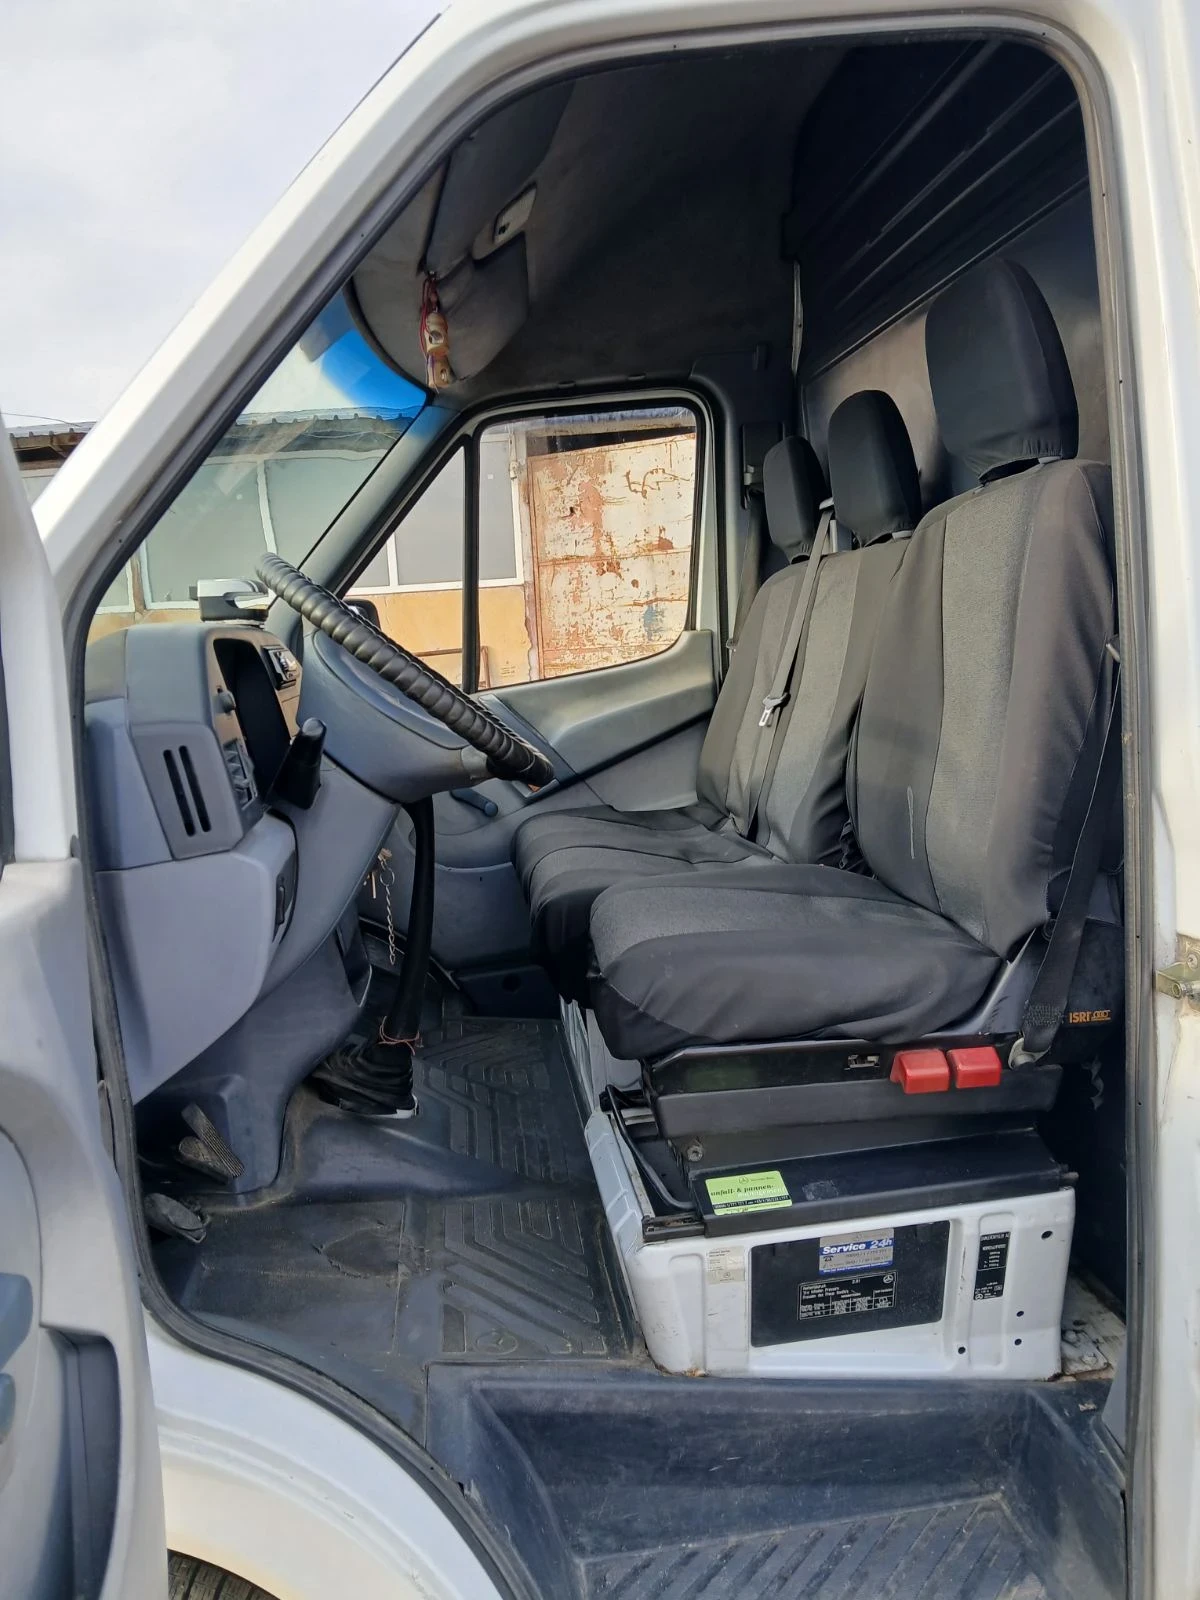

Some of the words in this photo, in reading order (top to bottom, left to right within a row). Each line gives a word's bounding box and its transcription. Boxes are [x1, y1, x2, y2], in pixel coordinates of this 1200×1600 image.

[1069, 1011, 1092, 1024] ISRI
[822, 1243, 866, 1255] Service
[869, 1238, 892, 1249] 24h
